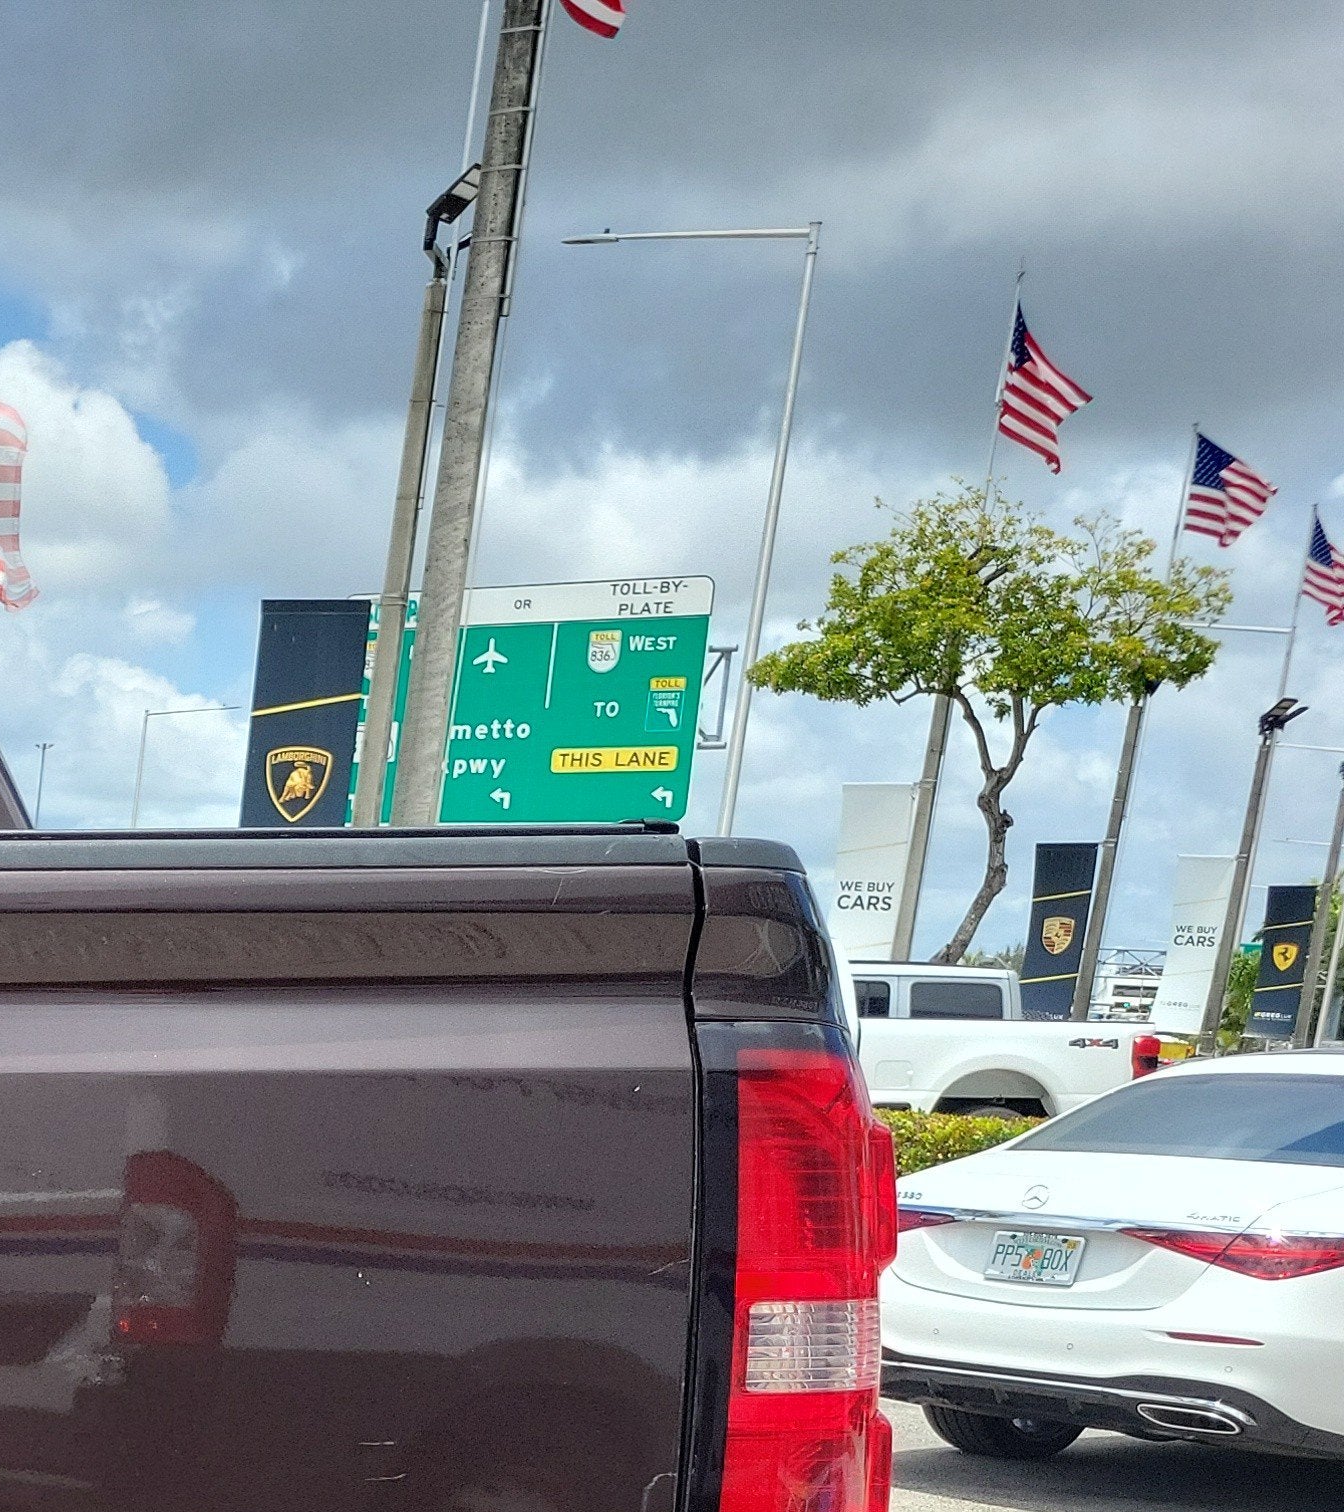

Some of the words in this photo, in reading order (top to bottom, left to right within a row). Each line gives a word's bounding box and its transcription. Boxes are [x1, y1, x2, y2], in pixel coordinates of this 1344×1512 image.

[610, 580, 688, 596] TOLL-BY-
[514, 599, 532, 610] OR
[618, 601, 674, 616] PLATE
[595, 633, 616, 641] TOLL
[629, 635, 677, 652] WEST
[590, 650, 611, 662] 836
[655, 680, 680, 688] TOLL
[593, 701, 619, 718] TO
[559, 752, 603, 767] THIS
[615, 752, 670, 767] LANE
[840, 881, 863, 891] WE
[867, 882, 895, 892] BUY
[837, 895, 893, 911] CARS
[1175, 925, 1193, 933] WE
[1196, 926, 1217, 934] BUY
[1173, 935, 1216, 947] CARS
